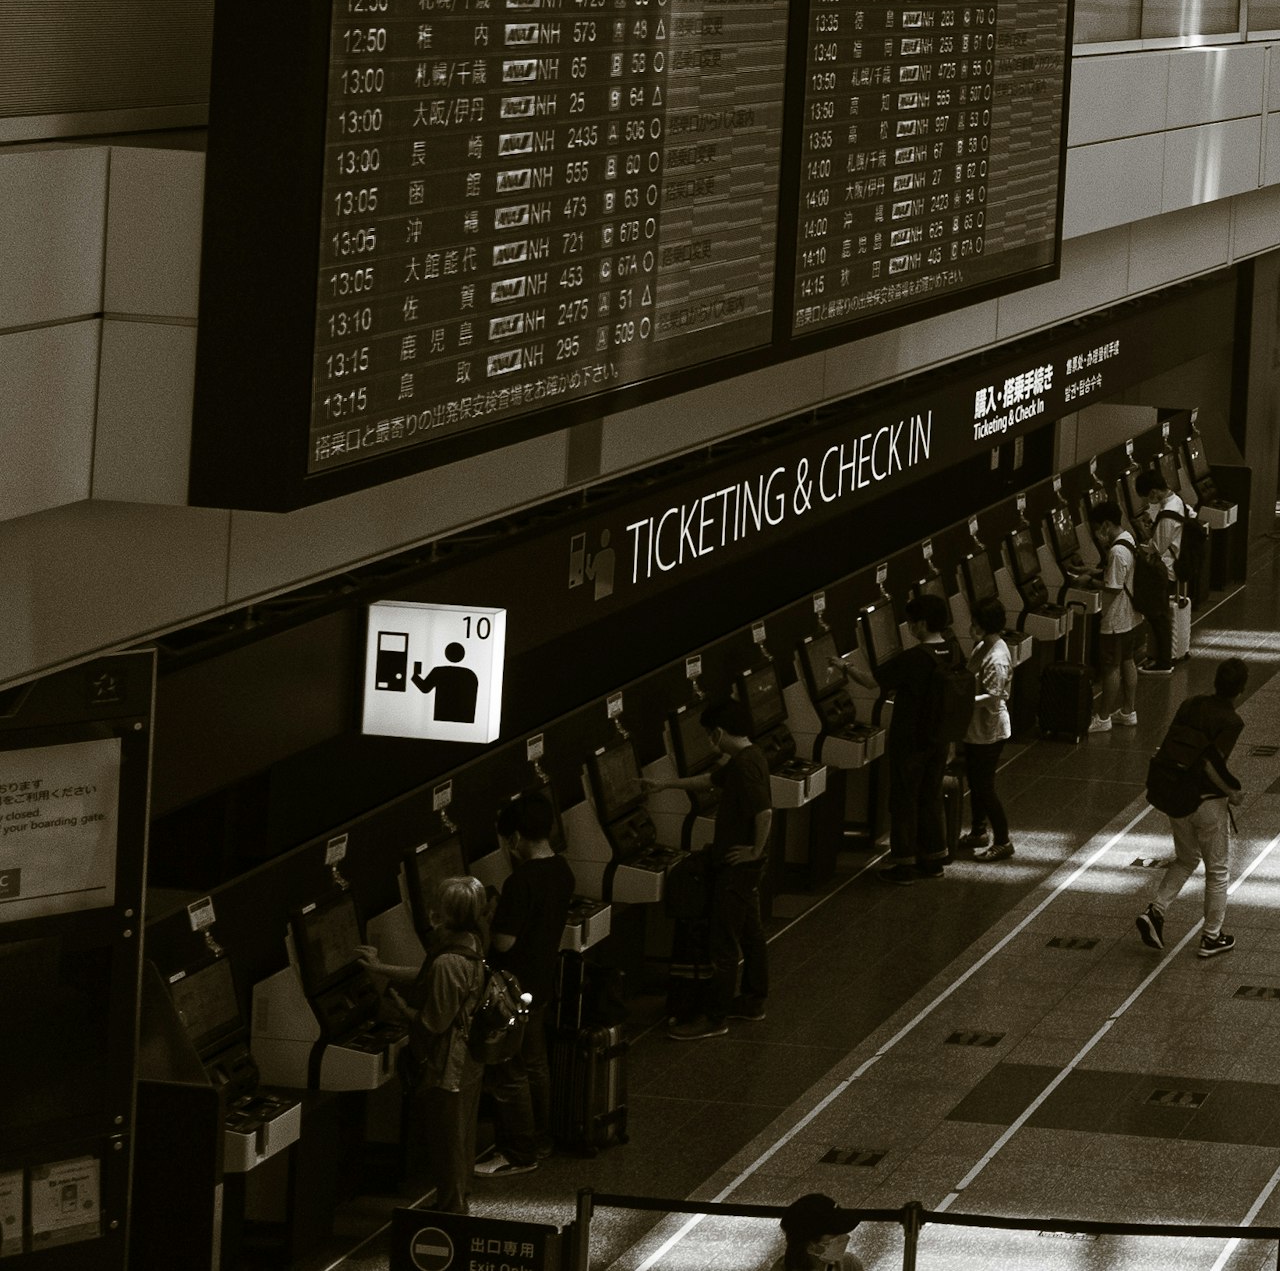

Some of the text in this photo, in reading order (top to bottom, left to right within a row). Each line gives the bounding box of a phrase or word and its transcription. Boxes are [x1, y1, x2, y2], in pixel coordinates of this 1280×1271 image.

[341, 26, 387, 53] 12:50
[539, 21, 561, 44] NH
[573, 21, 596, 42] 573
[633, 19, 649, 39] 48
[814, 14, 839, 32] 13:35
[813, 43, 837, 62] 13:40
[339, 66, 385, 93] 13:00
[537, 56, 559, 80] NH
[571, 56, 587, 77] 65
[631, 52, 647, 73] 58
[811, 72, 836, 91] 13:50
[337, 106, 383, 134] 13:00
[535, 92, 557, 116] NH
[569, 91, 585, 113] 25
[629, 86, 645, 106] 64
[809, 101, 834, 120] 13:50
[335, 145, 381, 175] 13:00
[533, 127, 556, 152] NH
[567, 124, 599, 148] 2435
[624, 119, 645, 141] 506
[808, 129, 833, 150] 13:55
[806, 158, 831, 179] 14:00
[333, 185, 378, 215] 13:05
[532, 163, 554, 188] NH
[565, 160, 589, 183] 555
[626, 153, 642, 174] 60
[805, 187, 830, 209] 14:00
[330, 225, 376, 256] 13:05
[530, 198, 552, 224] NH
[563, 195, 587, 219] 473
[624, 186, 640, 208] 63
[803, 216, 828, 238] 14:00
[328, 264, 374, 297] 13:05
[528, 234, 550, 260] NH
[562, 229, 586, 254] 721
[618, 220, 640, 243] 67B
[802, 245, 827, 268] 14:10
[326, 304, 372, 338] 13:10
[526, 270, 548, 296] NH
[560, 264, 584, 289] 453
[617, 253, 638, 277] 67A
[800, 274, 825, 297] 14:15
[324, 344, 370, 379] 13:15
[524, 305, 546, 333] NH
[558, 297, 590, 325] 2475
[619, 287, 635, 310] 51
[321, 384, 368, 420] 13:15
[522, 341, 544, 369] NH
[556, 334, 580, 360] 295
[613, 320, 635, 345] 509
[973, 363, 1054, 420] 購入・搭乗手続き
[973, 398, 1045, 441] Ticketing & Check In
[626, 410, 932, 584] TICKETING & CHECK IN
[462, 614, 491, 640] 10
[3, 824, 29, 835] your
[31, 815, 77, 830] boarding
[470, 1237, 534, 1259] 出口専用
[469, 1259, 495, 1271] Exit
